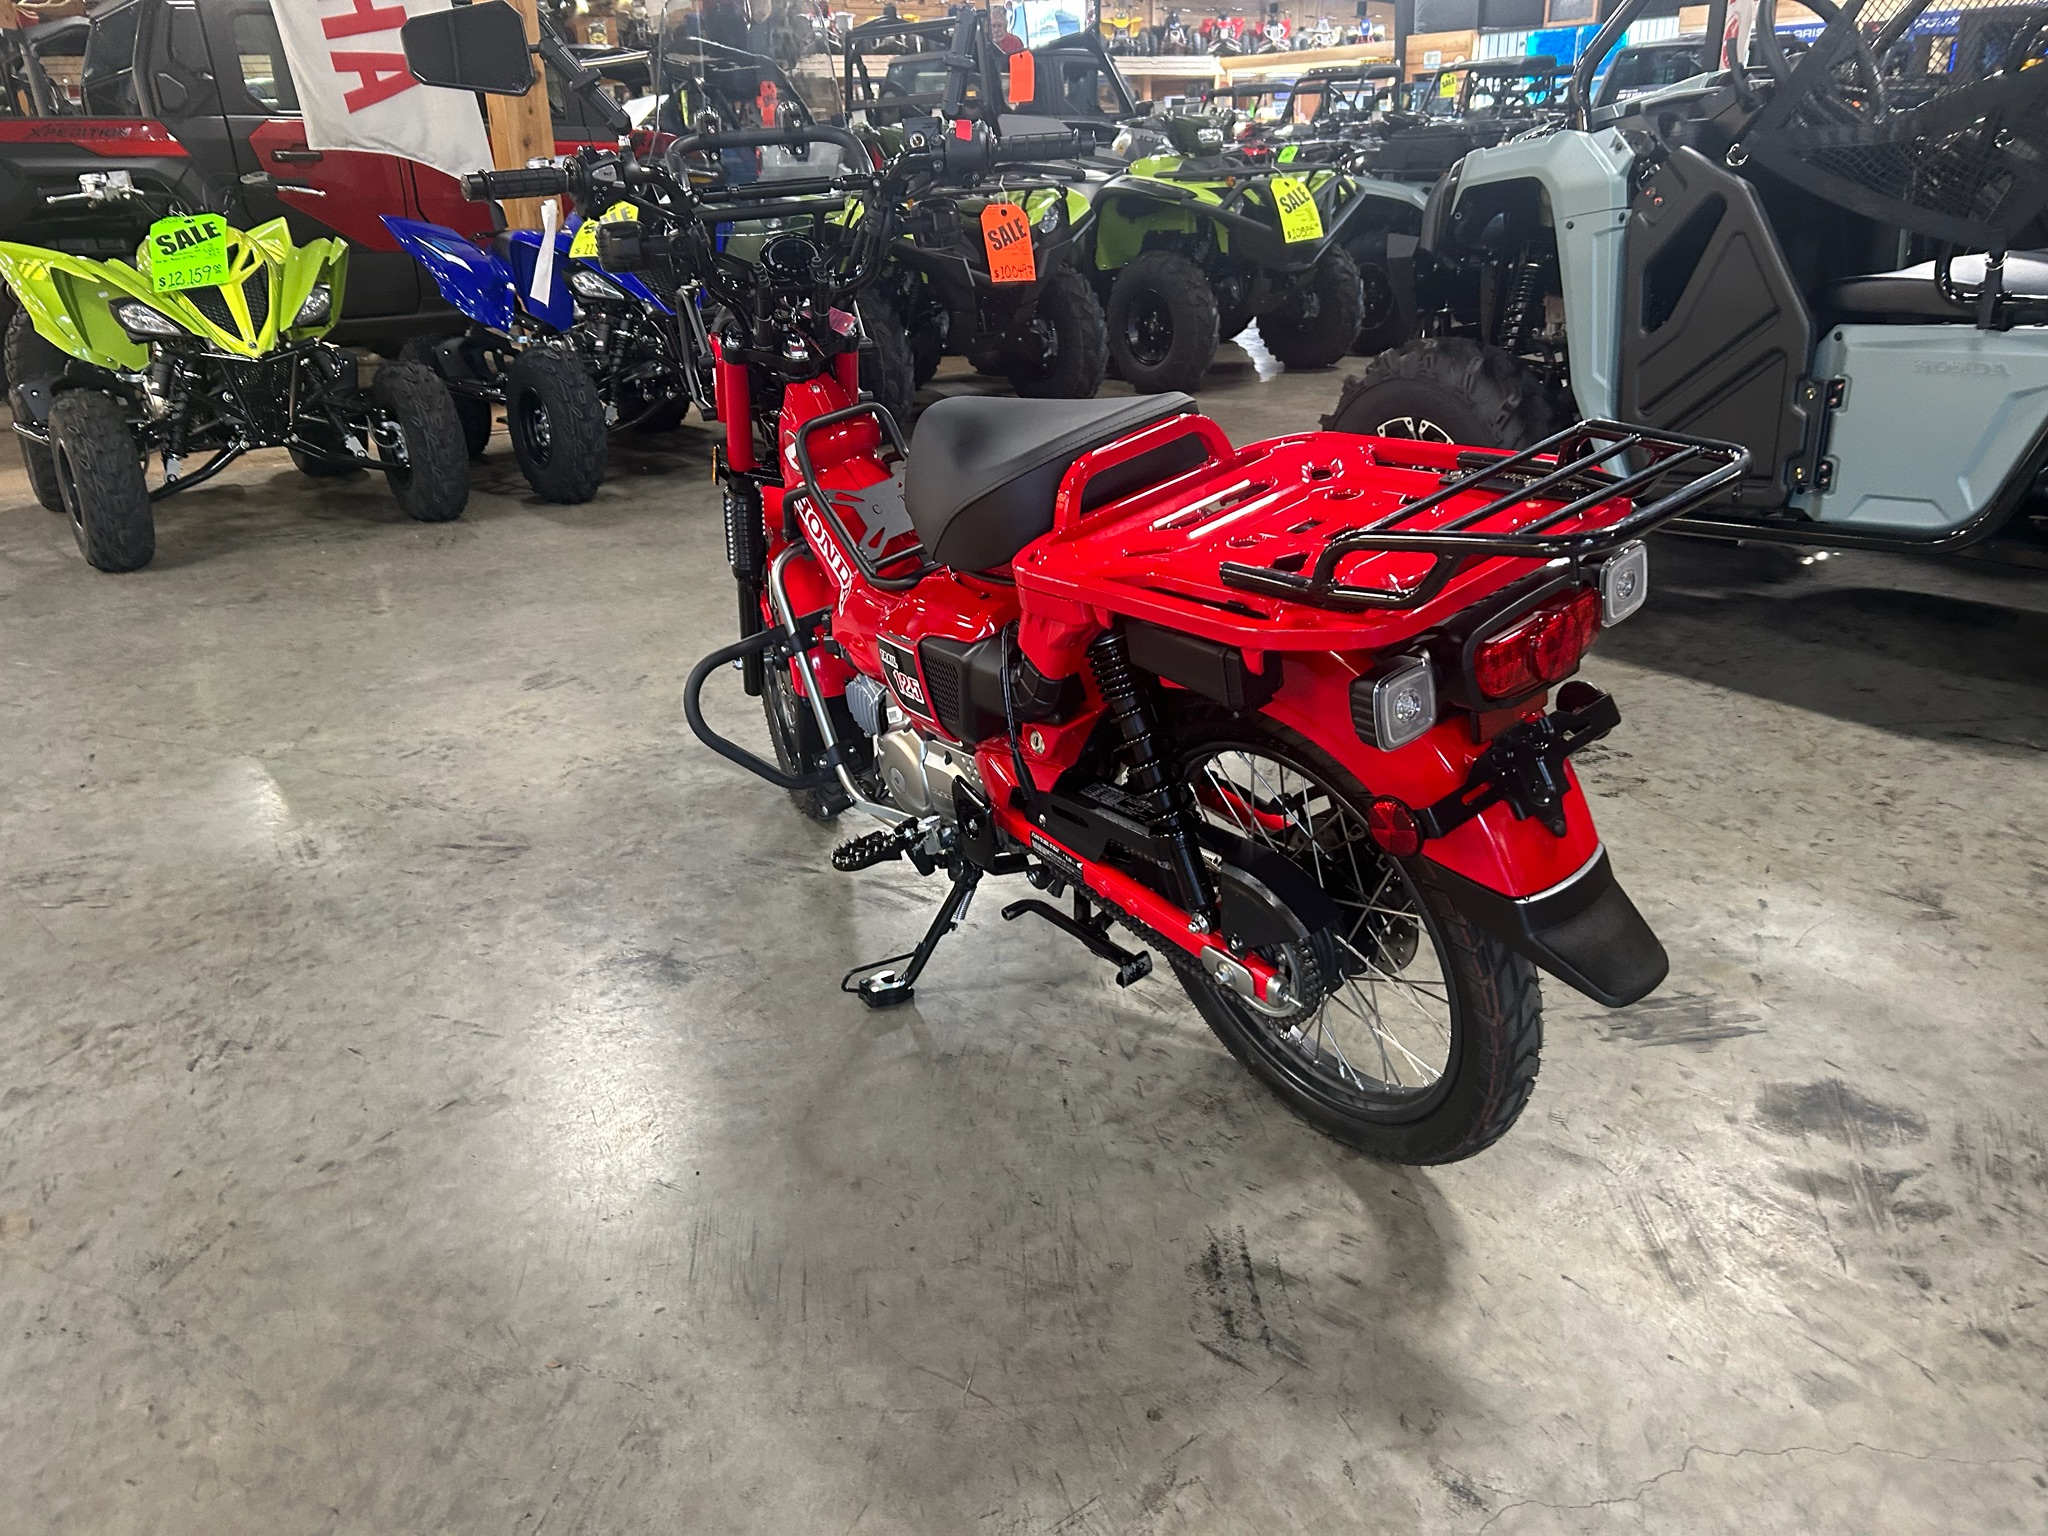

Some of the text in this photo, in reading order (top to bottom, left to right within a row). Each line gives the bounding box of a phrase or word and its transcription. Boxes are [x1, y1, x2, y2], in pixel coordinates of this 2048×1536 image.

[22, 122, 132, 139] XPEDITION
[1279, 186, 1310, 214] SALE
[155, 221, 222, 255] SALE
[987, 217, 1027, 250] SALE
[879, 648, 899, 669] TRAIL
[892, 669, 925, 704] 125
